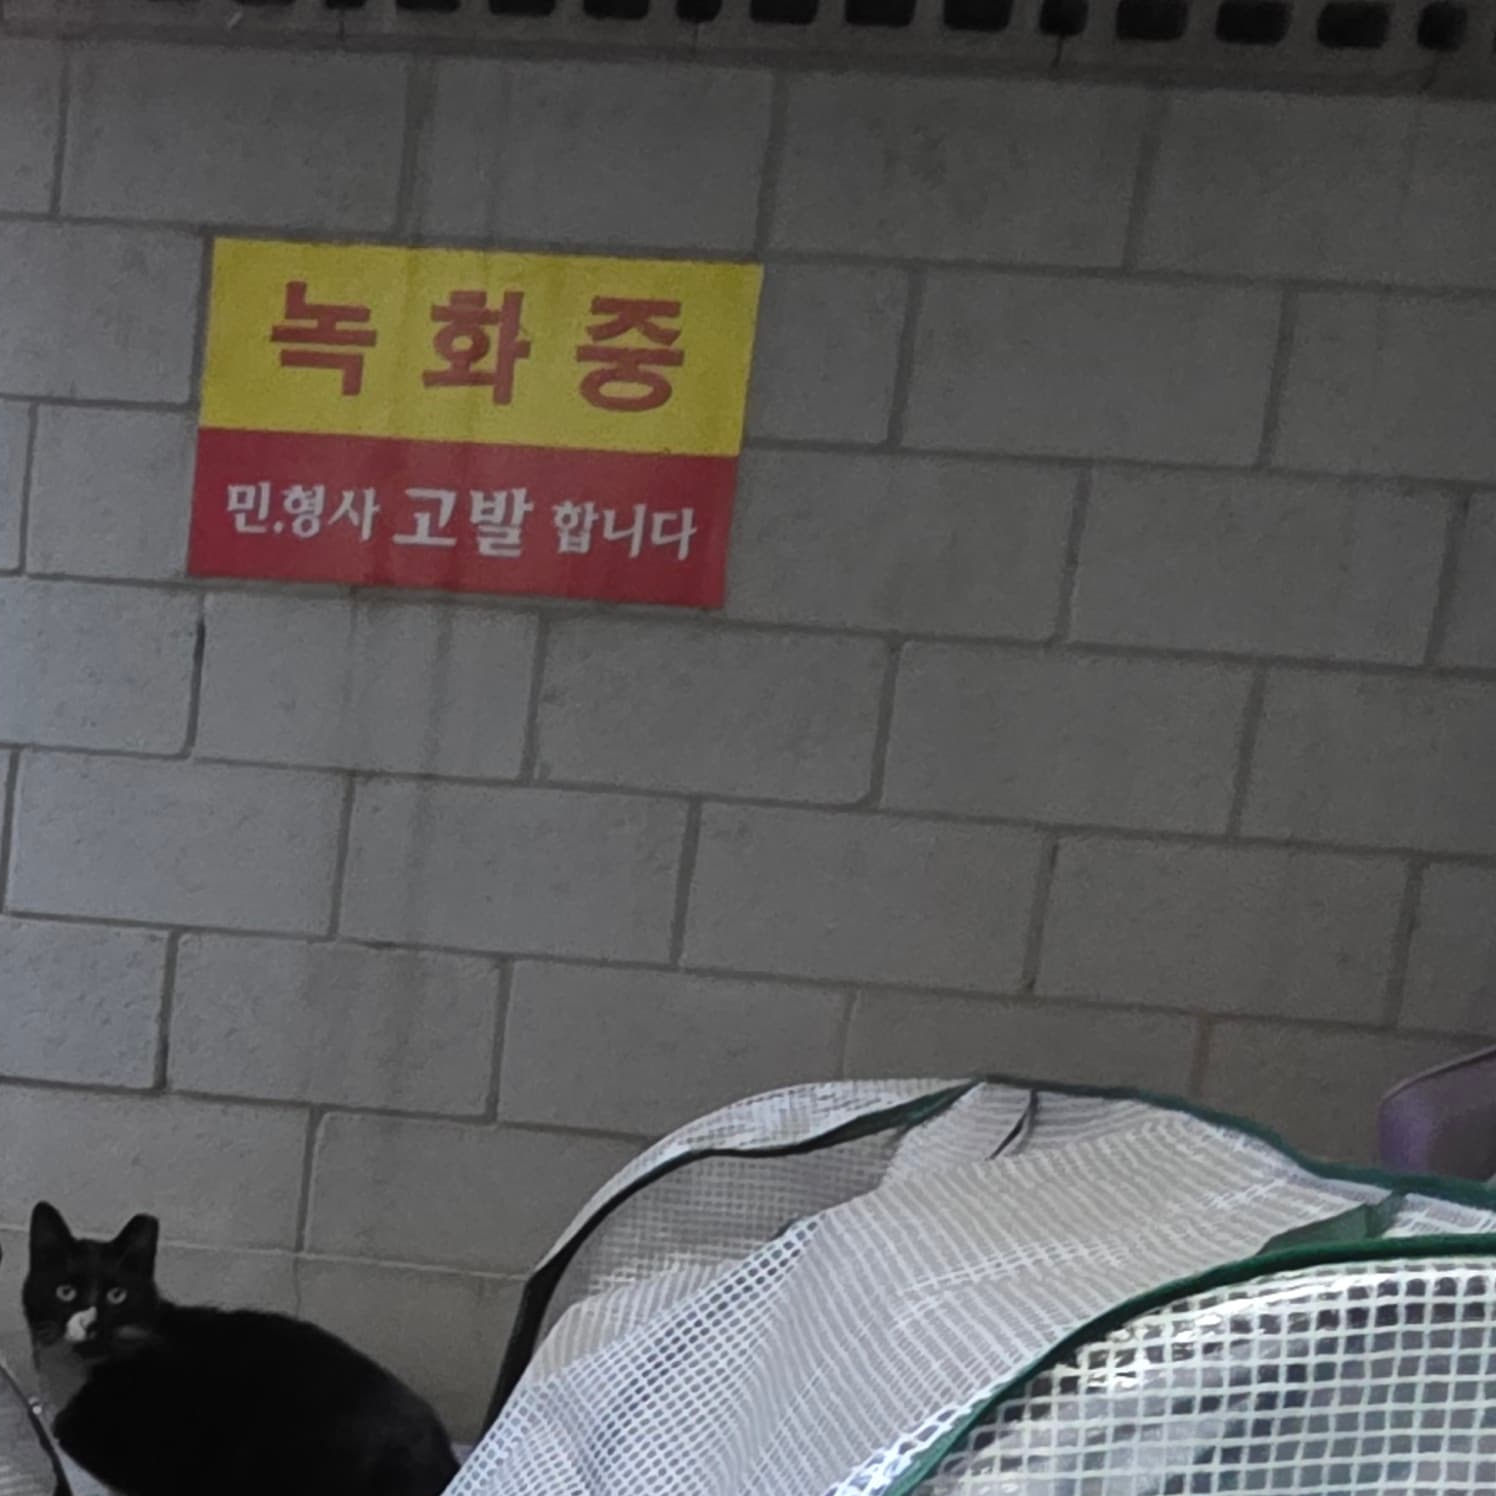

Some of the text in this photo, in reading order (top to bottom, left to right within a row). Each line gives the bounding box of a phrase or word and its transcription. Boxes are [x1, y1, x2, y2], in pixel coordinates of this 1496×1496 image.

[226, 481, 698, 560] 민.형사 고발 합니다
